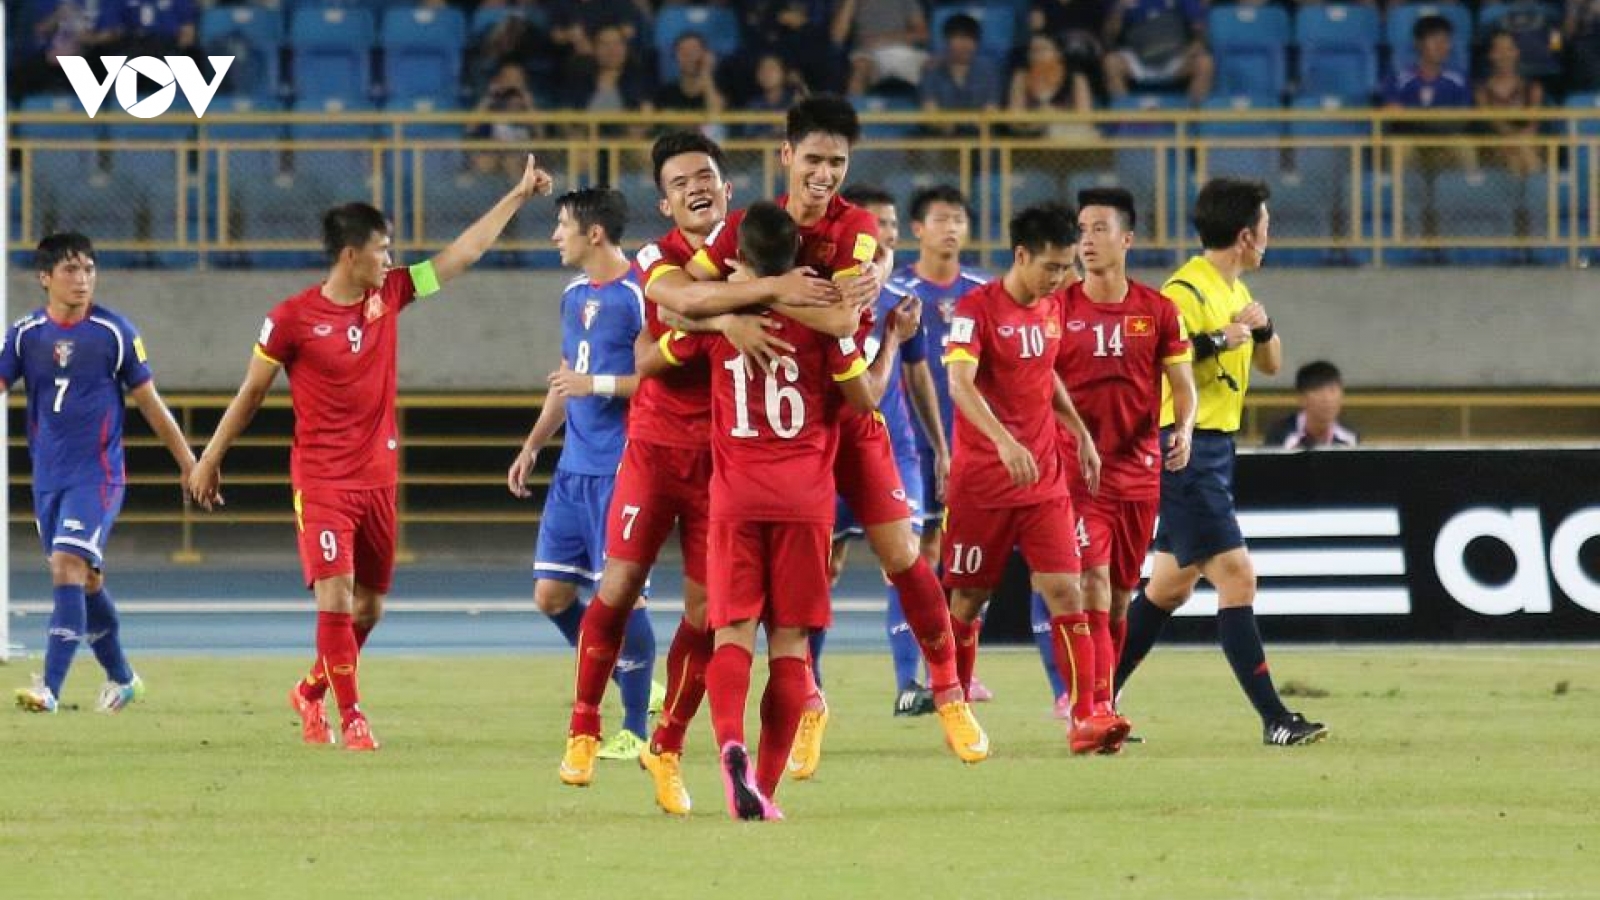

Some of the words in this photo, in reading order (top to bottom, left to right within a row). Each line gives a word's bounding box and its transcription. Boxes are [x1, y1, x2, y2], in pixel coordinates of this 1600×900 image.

[347, 325, 363, 353] 9
[1017, 324, 1045, 359] 10
[1092, 323, 1124, 357] 14
[575, 340, 590, 374] 8
[53, 377, 70, 413] 7
[724, 350, 806, 438] 16
[621, 504, 641, 540] 7
[319, 530, 337, 562] 9
[950, 543, 983, 574] 10
